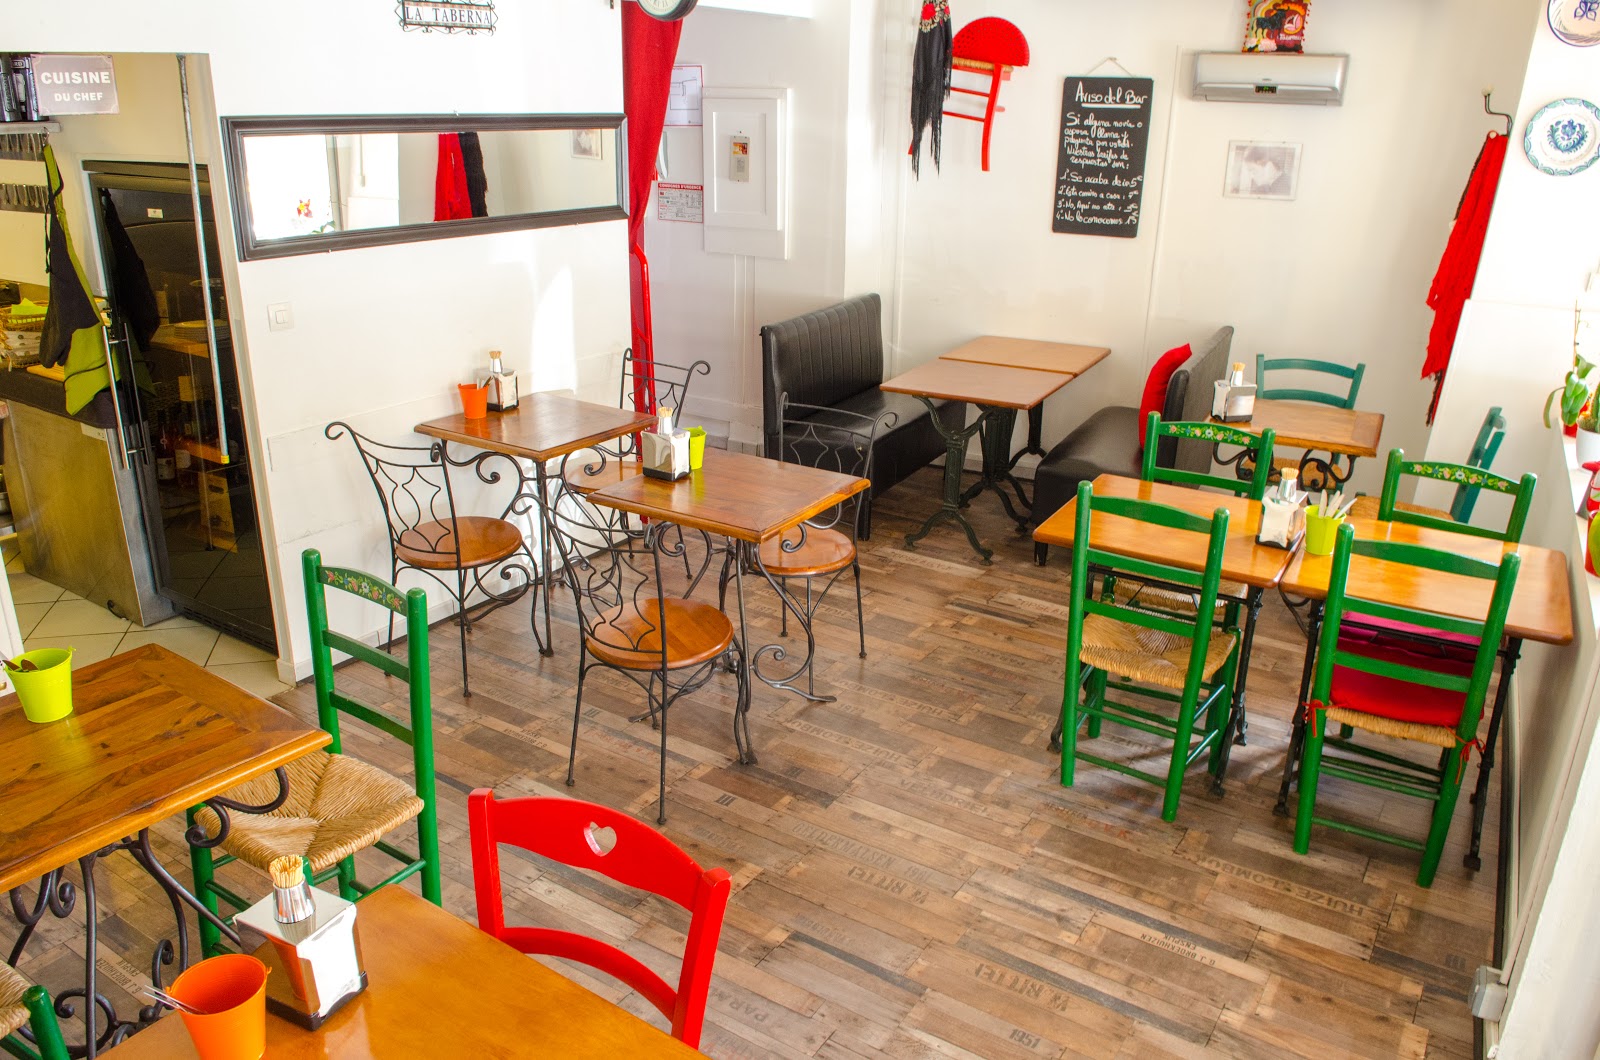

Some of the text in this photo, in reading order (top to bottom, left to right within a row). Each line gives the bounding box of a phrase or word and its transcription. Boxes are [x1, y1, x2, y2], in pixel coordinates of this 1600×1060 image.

[405, 6, 491, 25] LA TABERNA
[41, 71, 111, 84] CUISINE
[54, 92, 103, 102] DU CHEF
[1075, 81, 1148, 104] Aviso del Bar
[1066, 112, 1081, 126] Si
[1295, 888, 1364, 917] HUIZE
[1008, 1028, 1041, 1050] 1951
